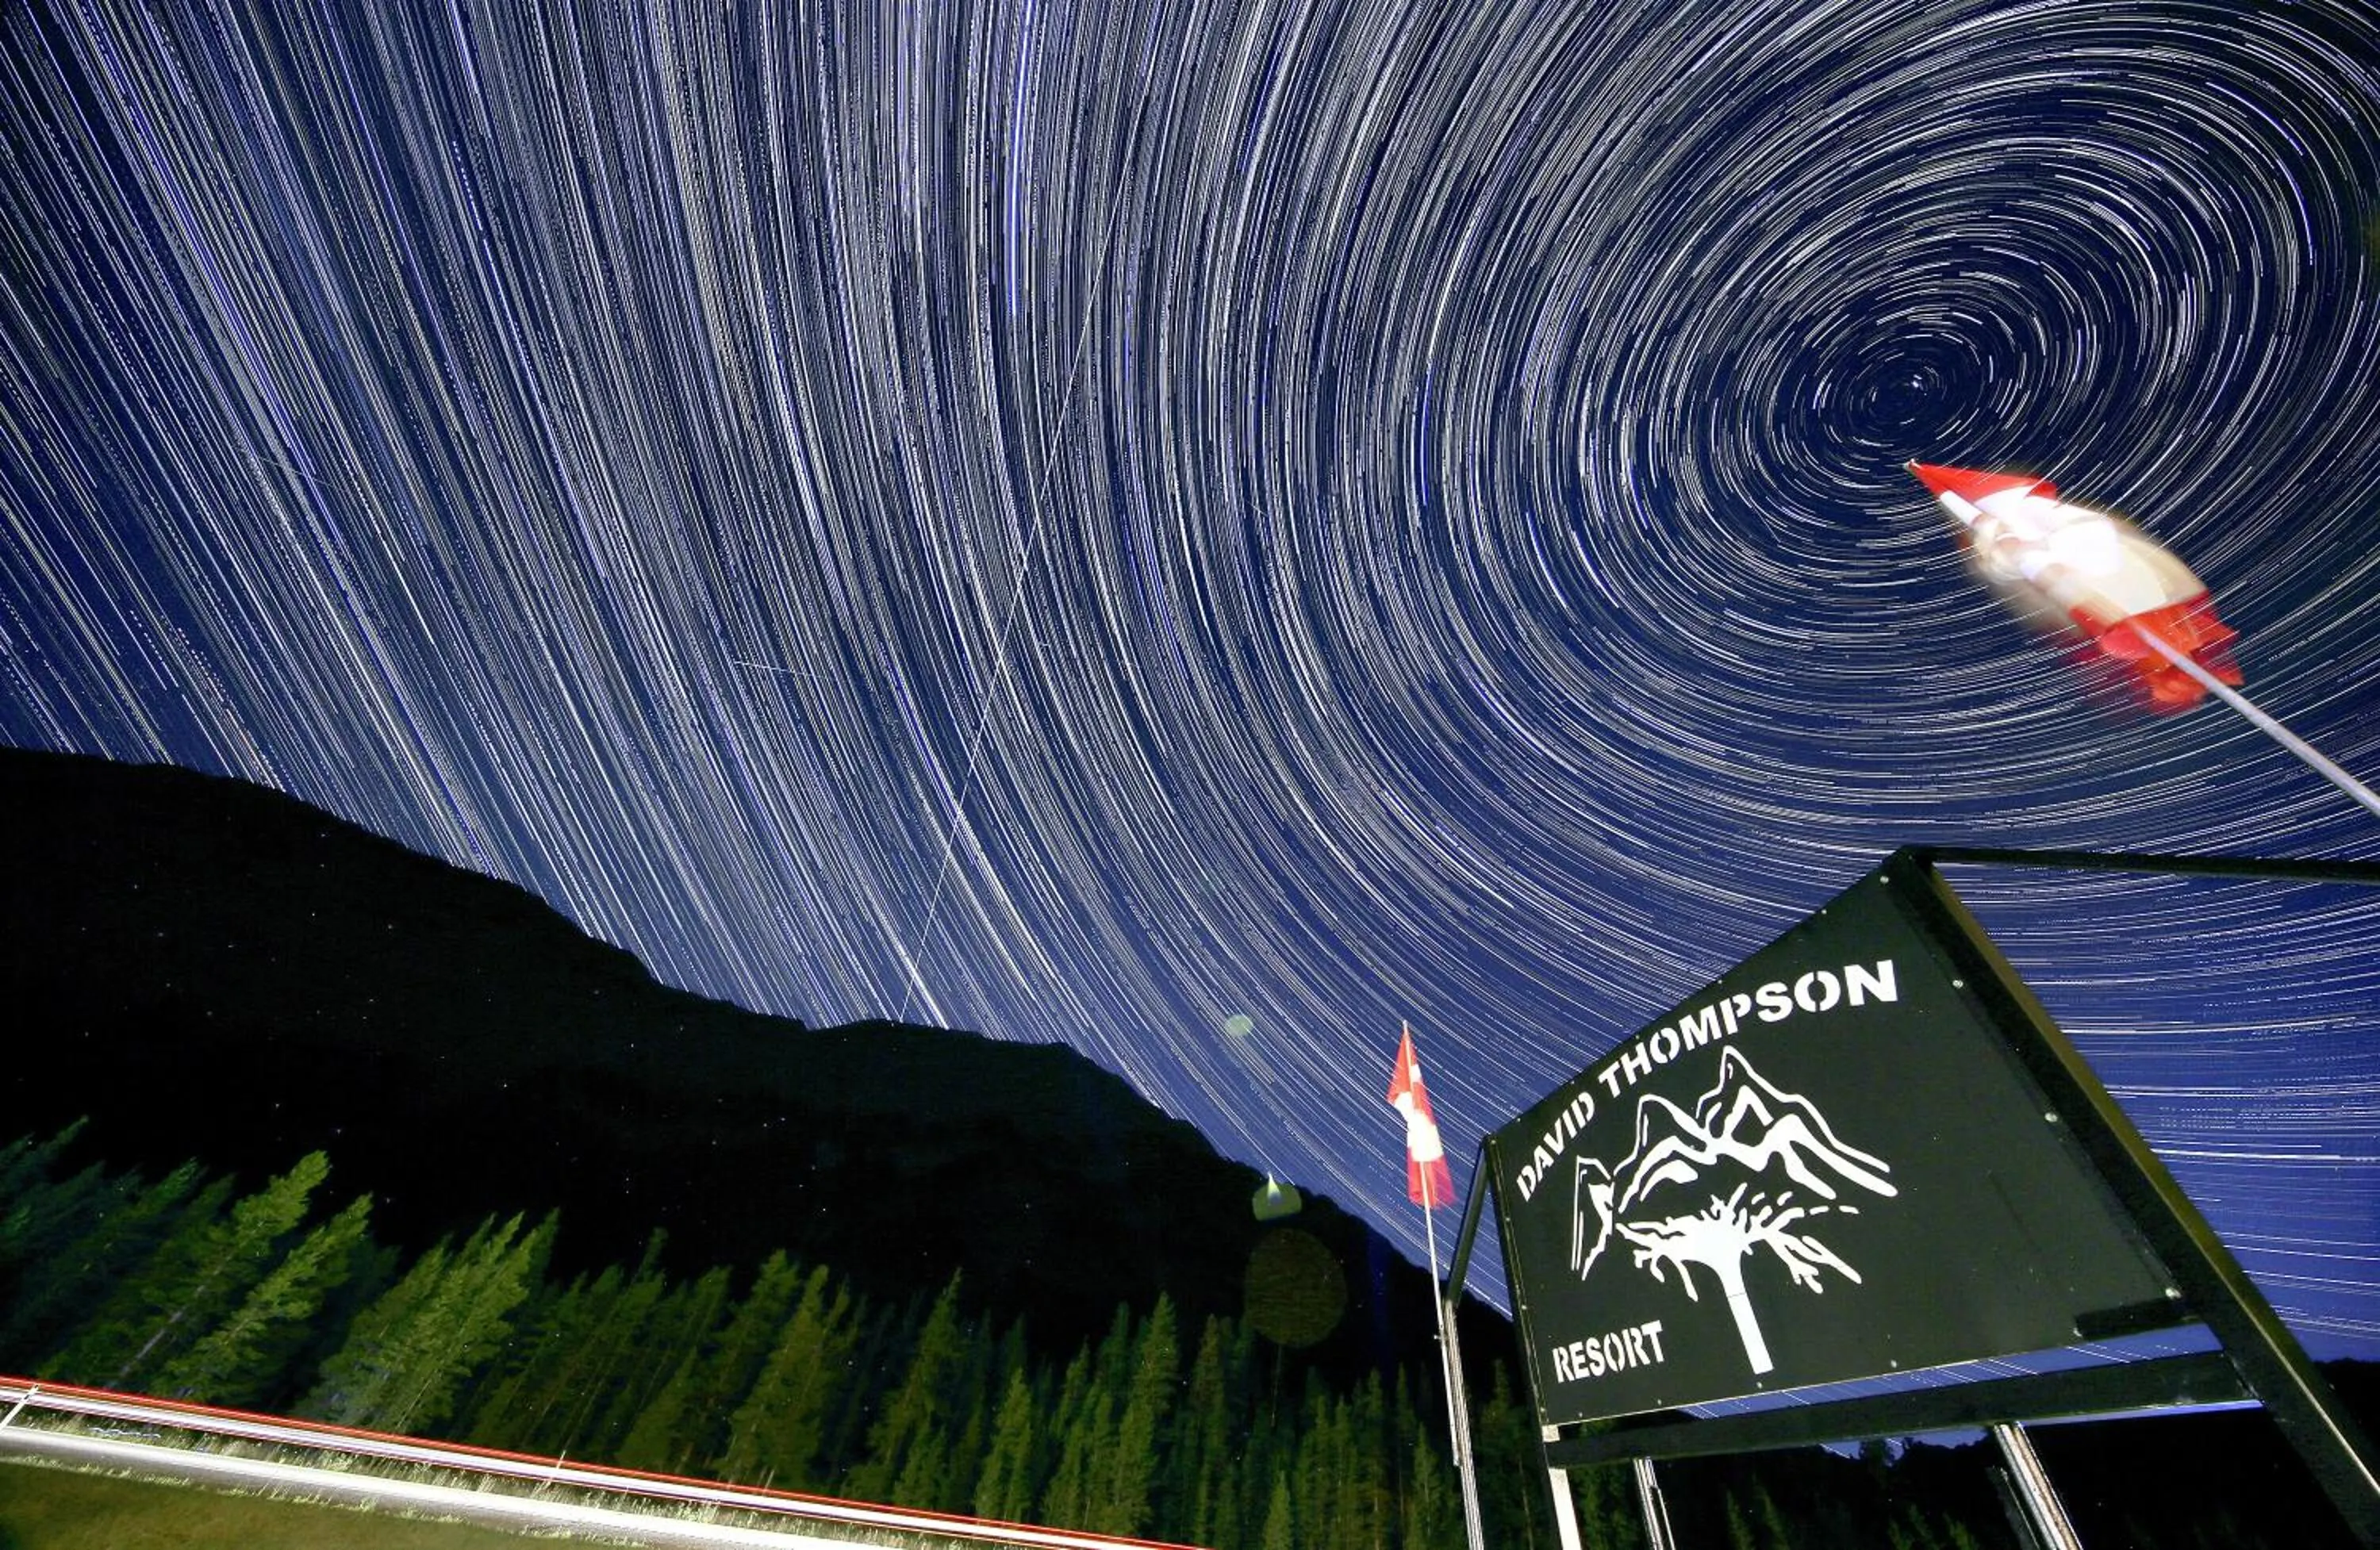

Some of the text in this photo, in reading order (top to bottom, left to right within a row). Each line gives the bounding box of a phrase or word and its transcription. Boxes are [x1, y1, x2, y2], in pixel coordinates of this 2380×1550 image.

[1515, 958, 1898, 1203] DAVID THOMPSON
[1551, 1318, 1664, 1383] RESORT
